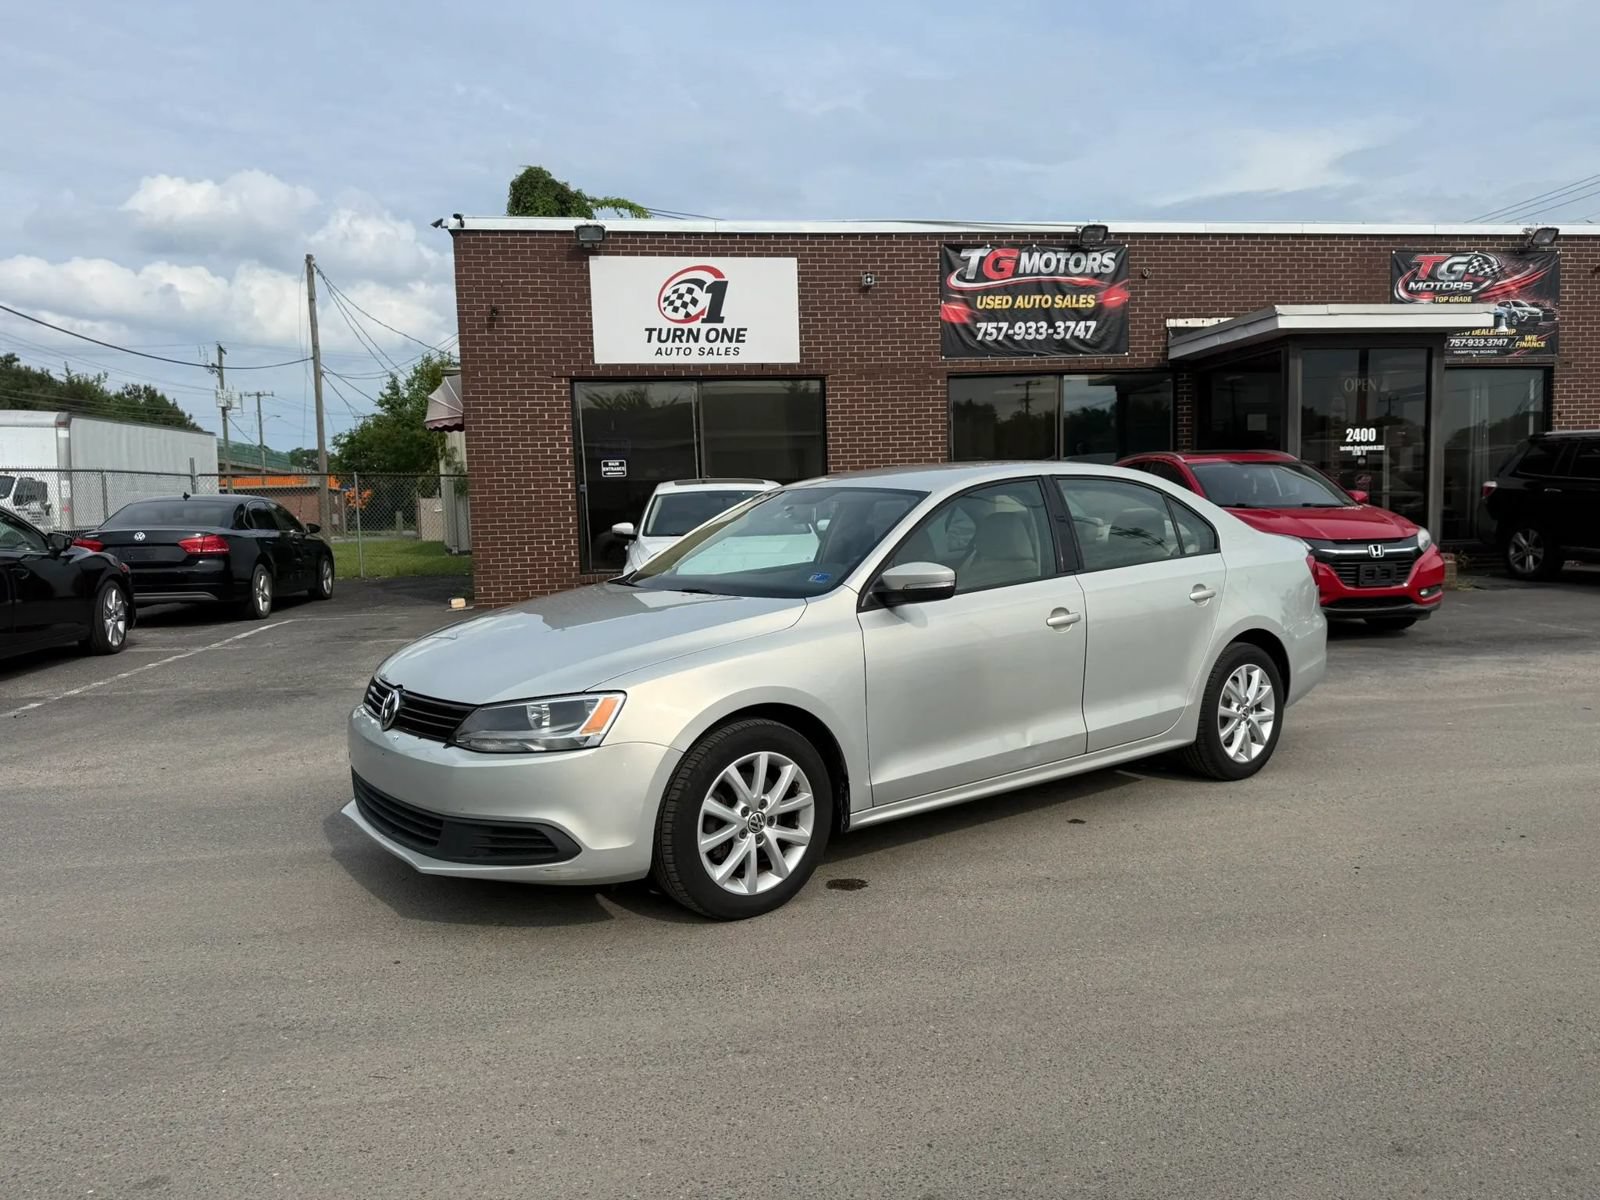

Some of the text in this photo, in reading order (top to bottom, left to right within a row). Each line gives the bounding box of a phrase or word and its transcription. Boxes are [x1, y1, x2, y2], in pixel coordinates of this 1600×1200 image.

[960, 248, 1117, 280] TG MOTORS
[1411, 254, 1475, 281] TG
[1407, 281, 1474, 291] MOTORS
[700, 280, 729, 324] 1
[976, 294, 1096, 309] USED AUTO SALES
[644, 327, 748, 344] TURN ONE
[976, 320, 1097, 341] 757-933-3747
[1471, 328, 1517, 336] DEALEIP
[1449, 338, 1509, 347] 757-933-3747
[654, 346, 741, 357] AUTO SALES
[1343, 377, 1377, 393] OPEN
[1345, 427, 1377, 442] 2400
